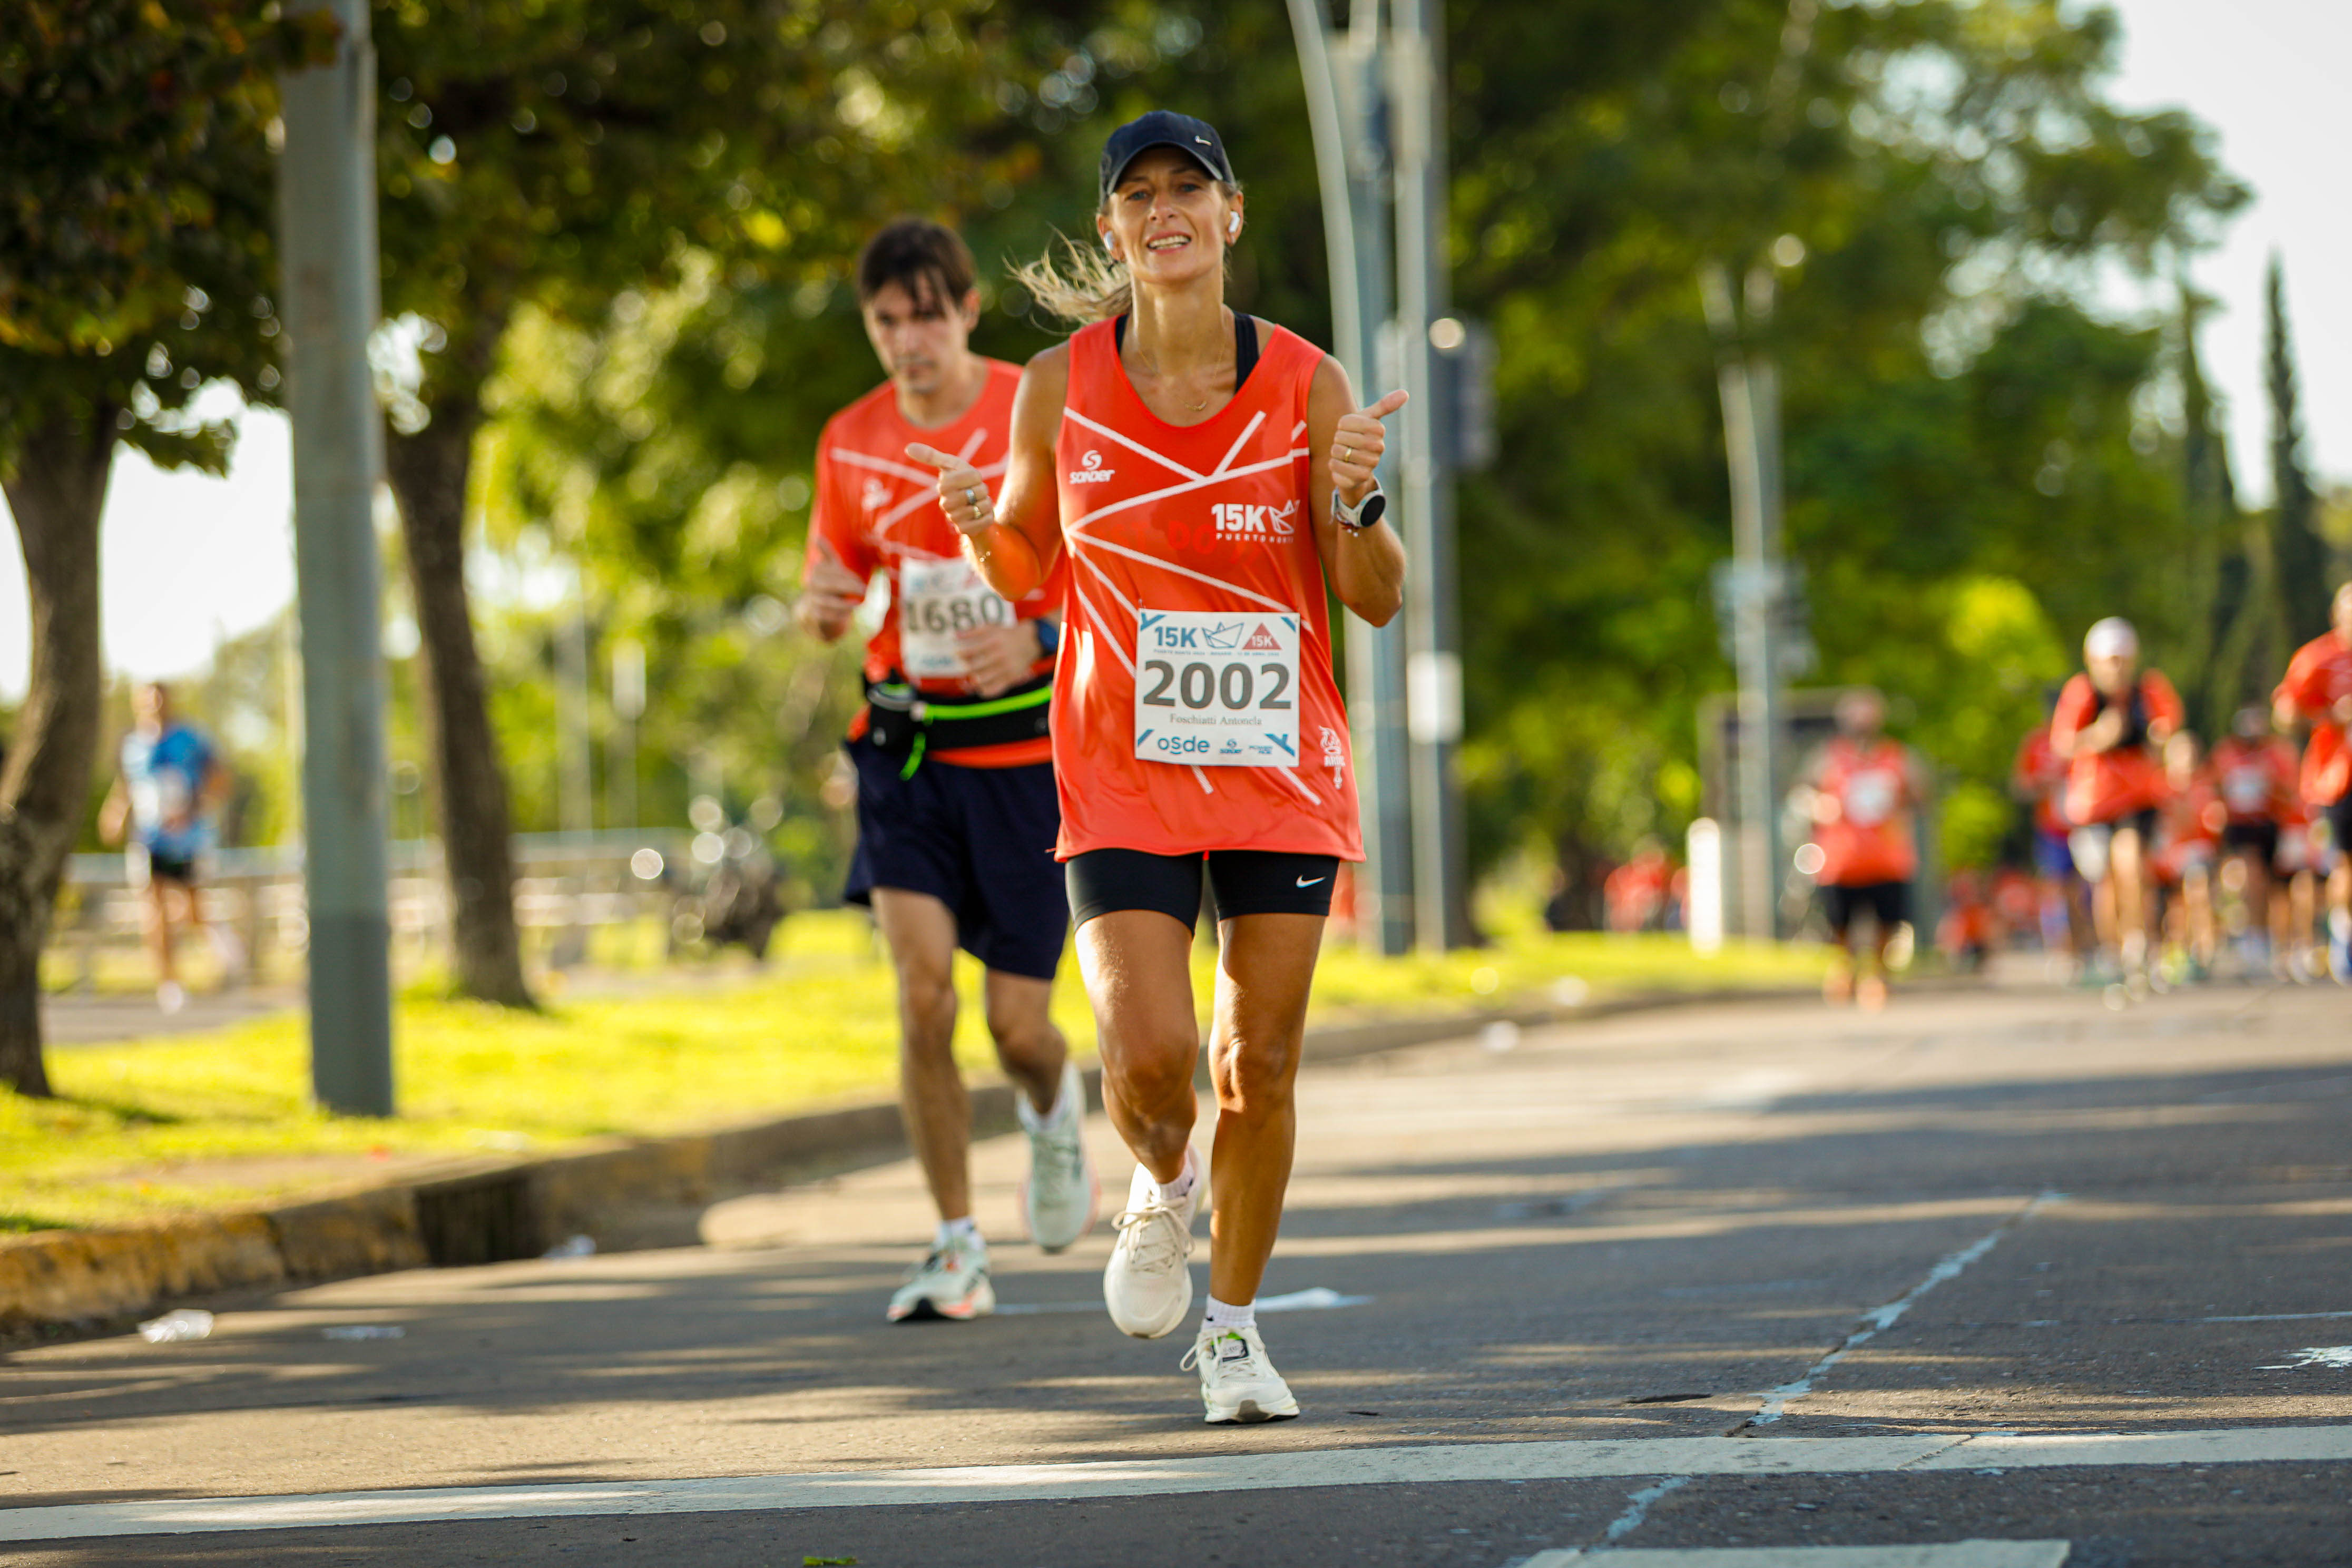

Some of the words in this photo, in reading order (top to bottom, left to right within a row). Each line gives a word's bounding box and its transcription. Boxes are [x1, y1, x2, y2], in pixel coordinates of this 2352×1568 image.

[1211, 503, 1266, 533] 15K
[1216, 533, 1266, 543] PUERTO
[906, 592, 1003, 634] 1680
[1154, 626, 1198, 648] 15K
[1251, 636, 1273, 647] 15K
[1143, 660, 1291, 710] 2002
[1157, 736, 1210, 754] osde
